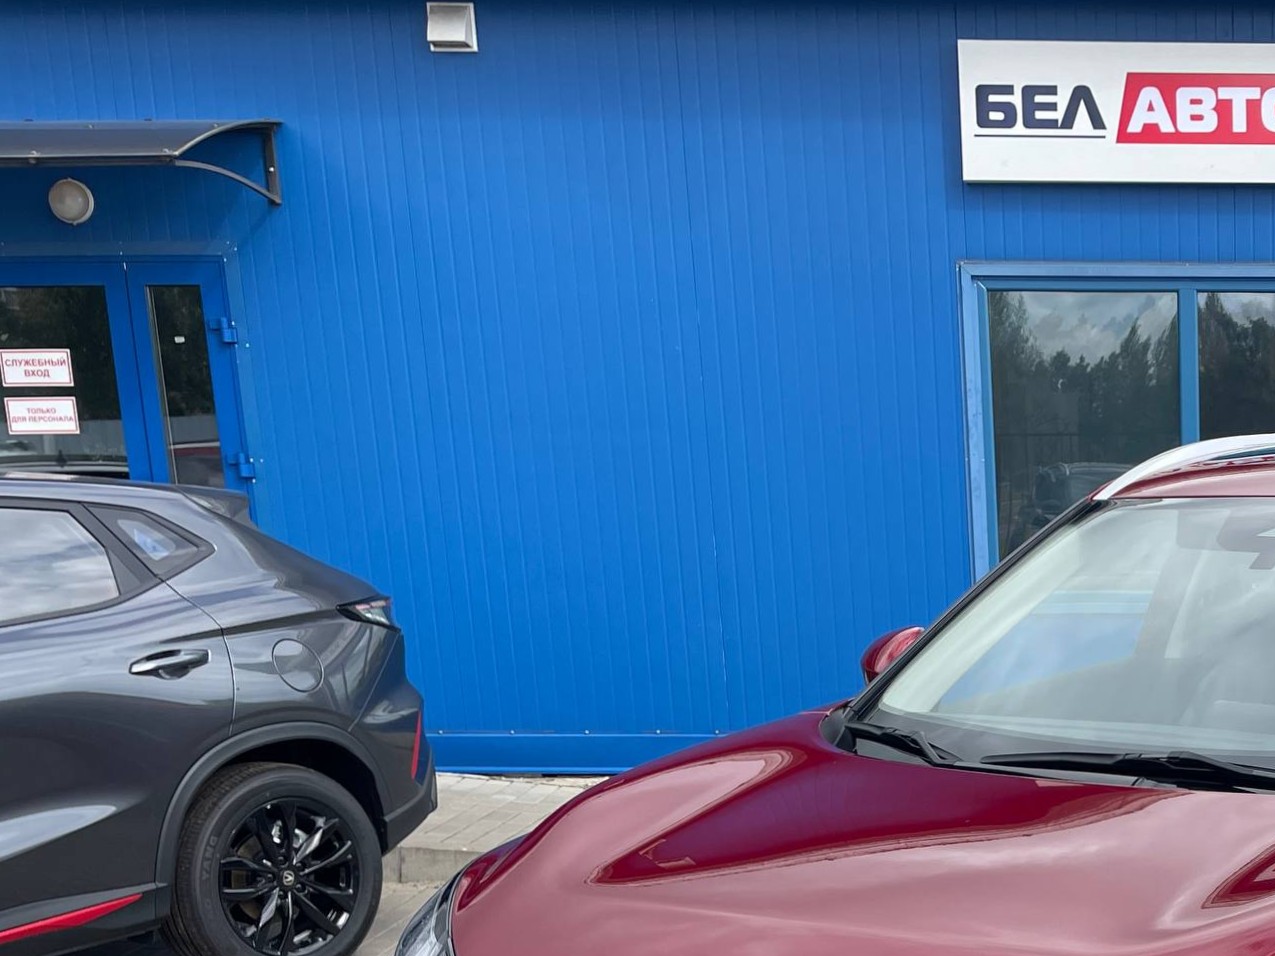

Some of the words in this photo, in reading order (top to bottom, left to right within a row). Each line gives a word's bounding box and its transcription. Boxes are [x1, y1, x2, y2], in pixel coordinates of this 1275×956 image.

[4, 356, 67, 367] СЛУЖЕБНЫЙ
[24, 369, 51, 378] ВХОД
[26, 407, 57, 415] ТОЛЬКО
